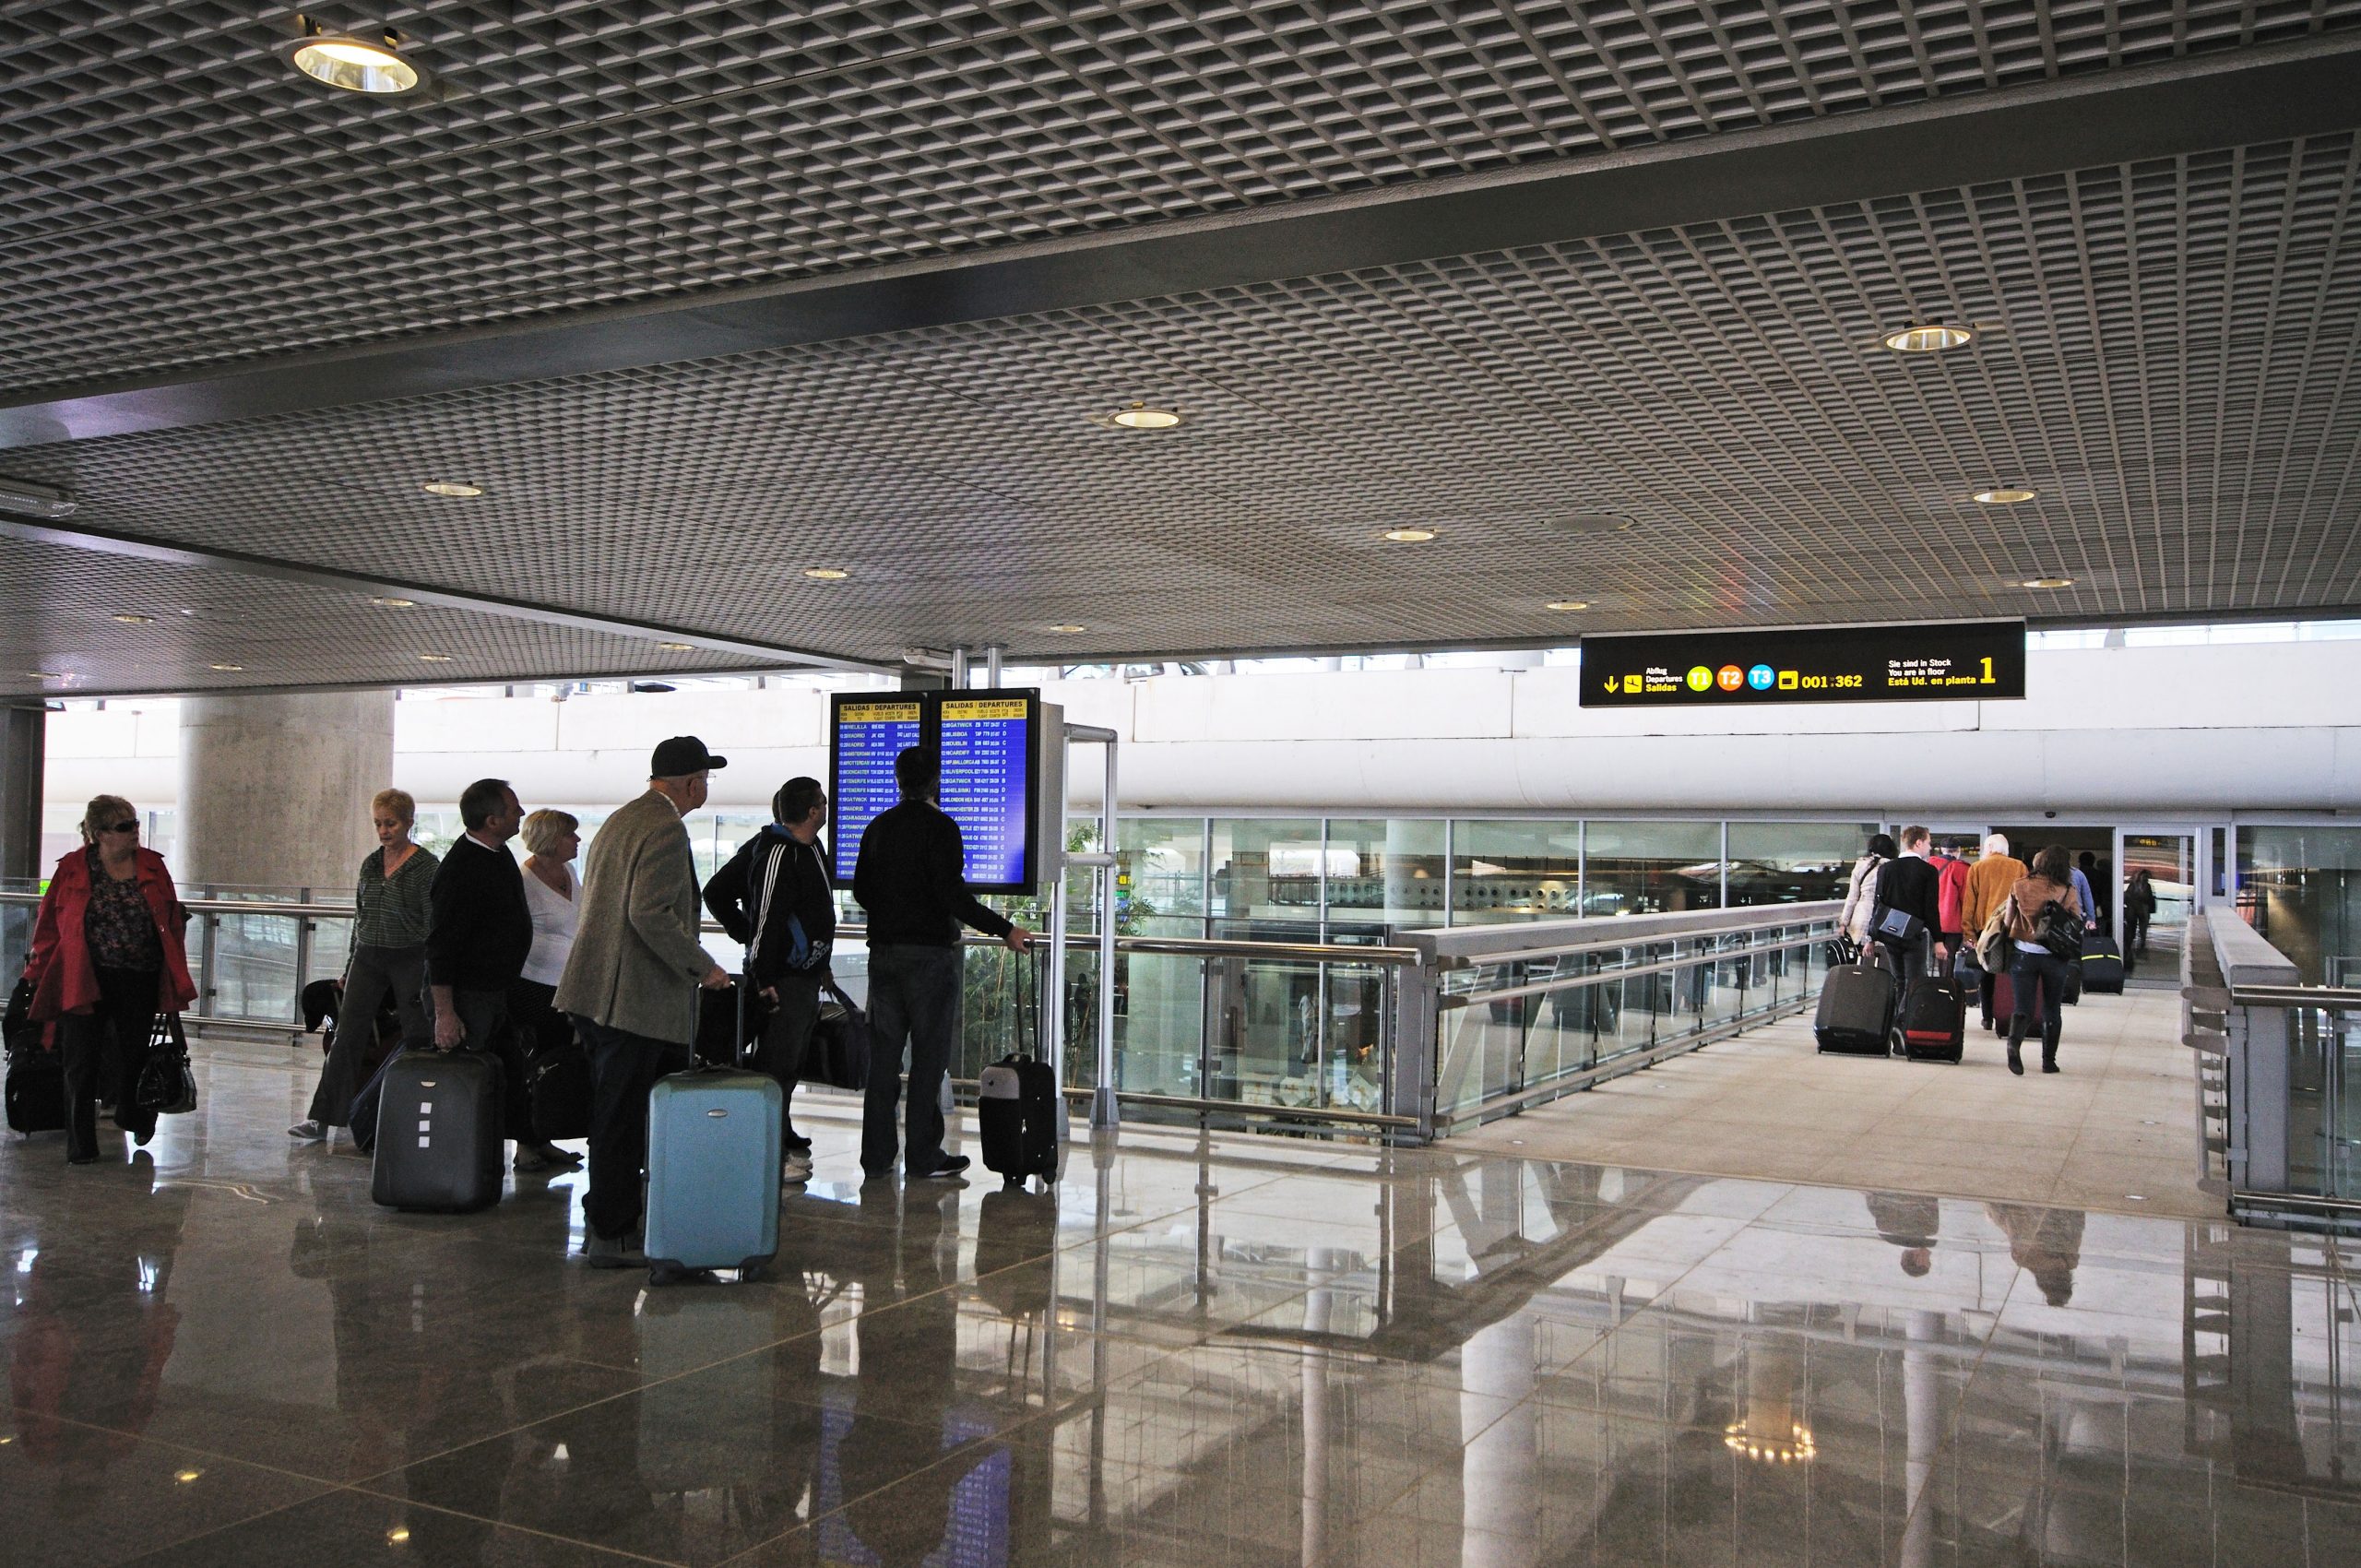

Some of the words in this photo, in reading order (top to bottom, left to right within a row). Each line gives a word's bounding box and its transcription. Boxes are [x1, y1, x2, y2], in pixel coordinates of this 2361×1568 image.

[1929, 659, 1952, 667] Stock
[1646, 667, 1667, 676] Abflug
[1980, 657, 1996, 684] 1
[1646, 675, 1683, 683] Departures
[1690, 672, 1708, 685] T1
[1720, 671, 1740, 685] T2
[1751, 670, 1771, 684] T3
[1888, 677, 1909, 686] Está
[1912, 677, 1928, 685] Ud.
[1946, 676, 1976, 686] planta
[1646, 683, 1677, 692] Salidas
